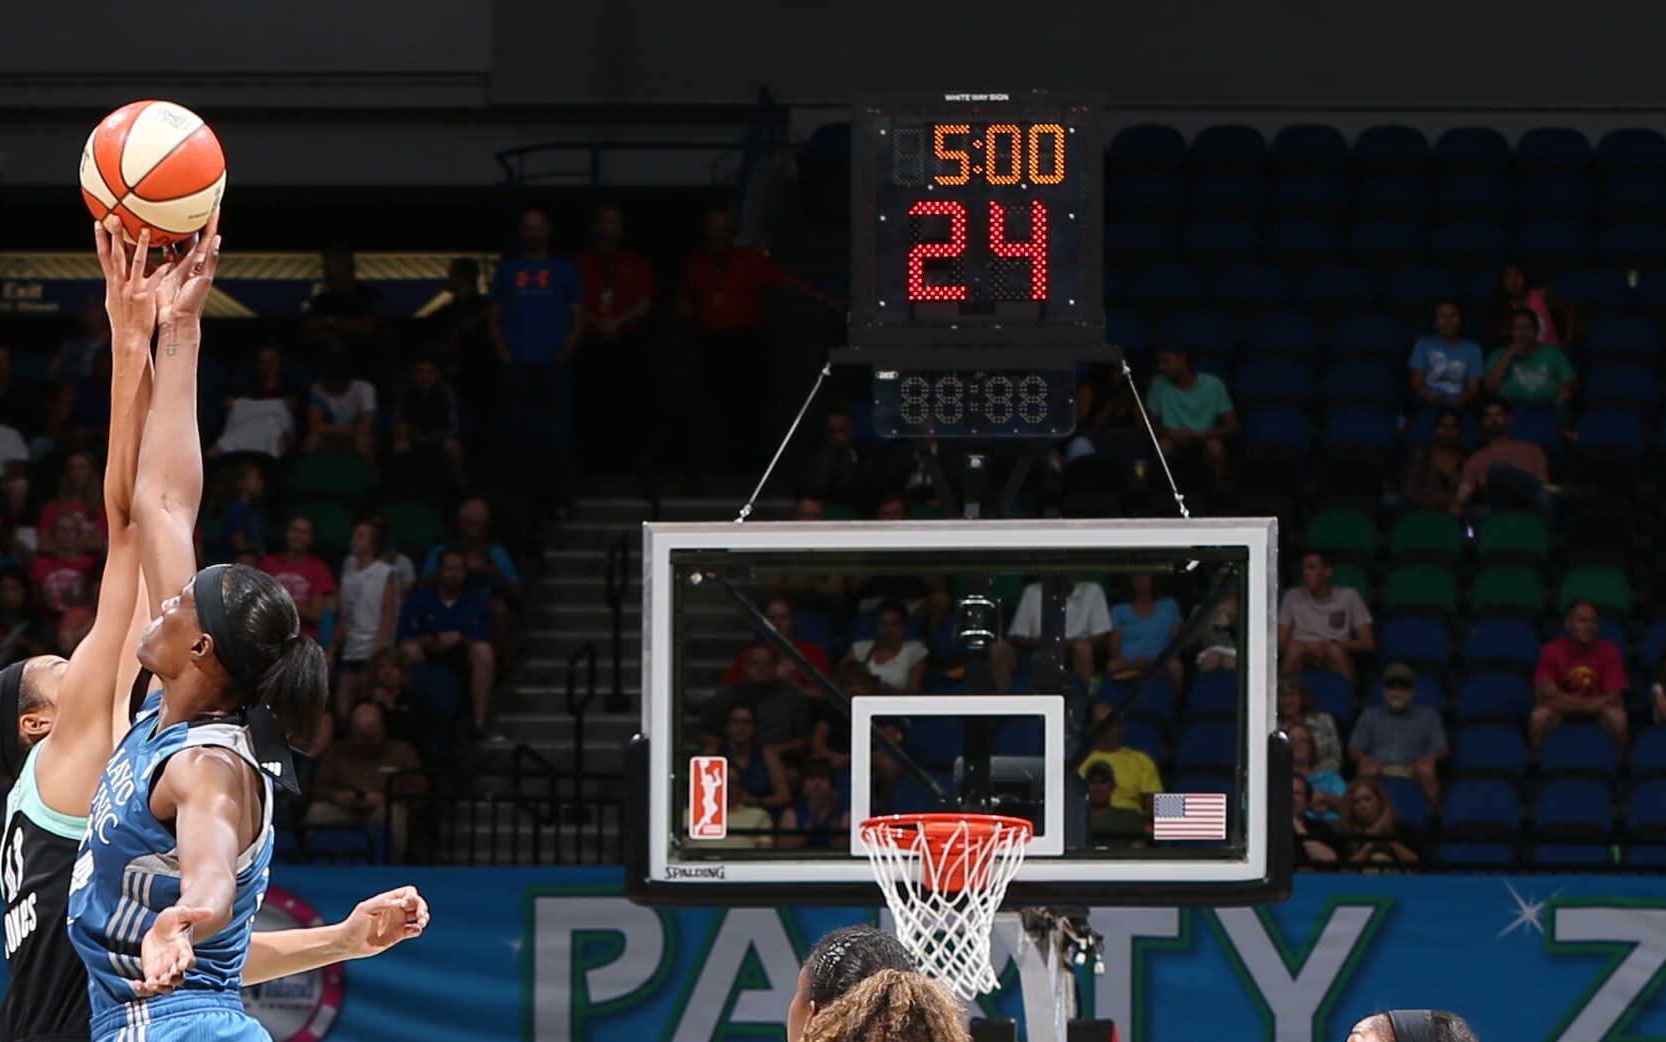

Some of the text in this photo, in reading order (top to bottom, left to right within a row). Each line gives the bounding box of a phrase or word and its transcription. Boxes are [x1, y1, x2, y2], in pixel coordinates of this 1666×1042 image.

[933, 123, 1066, 186] 5:00
[907, 199, 1048, 302] 24
[665, 866, 725, 880] SPALDING
